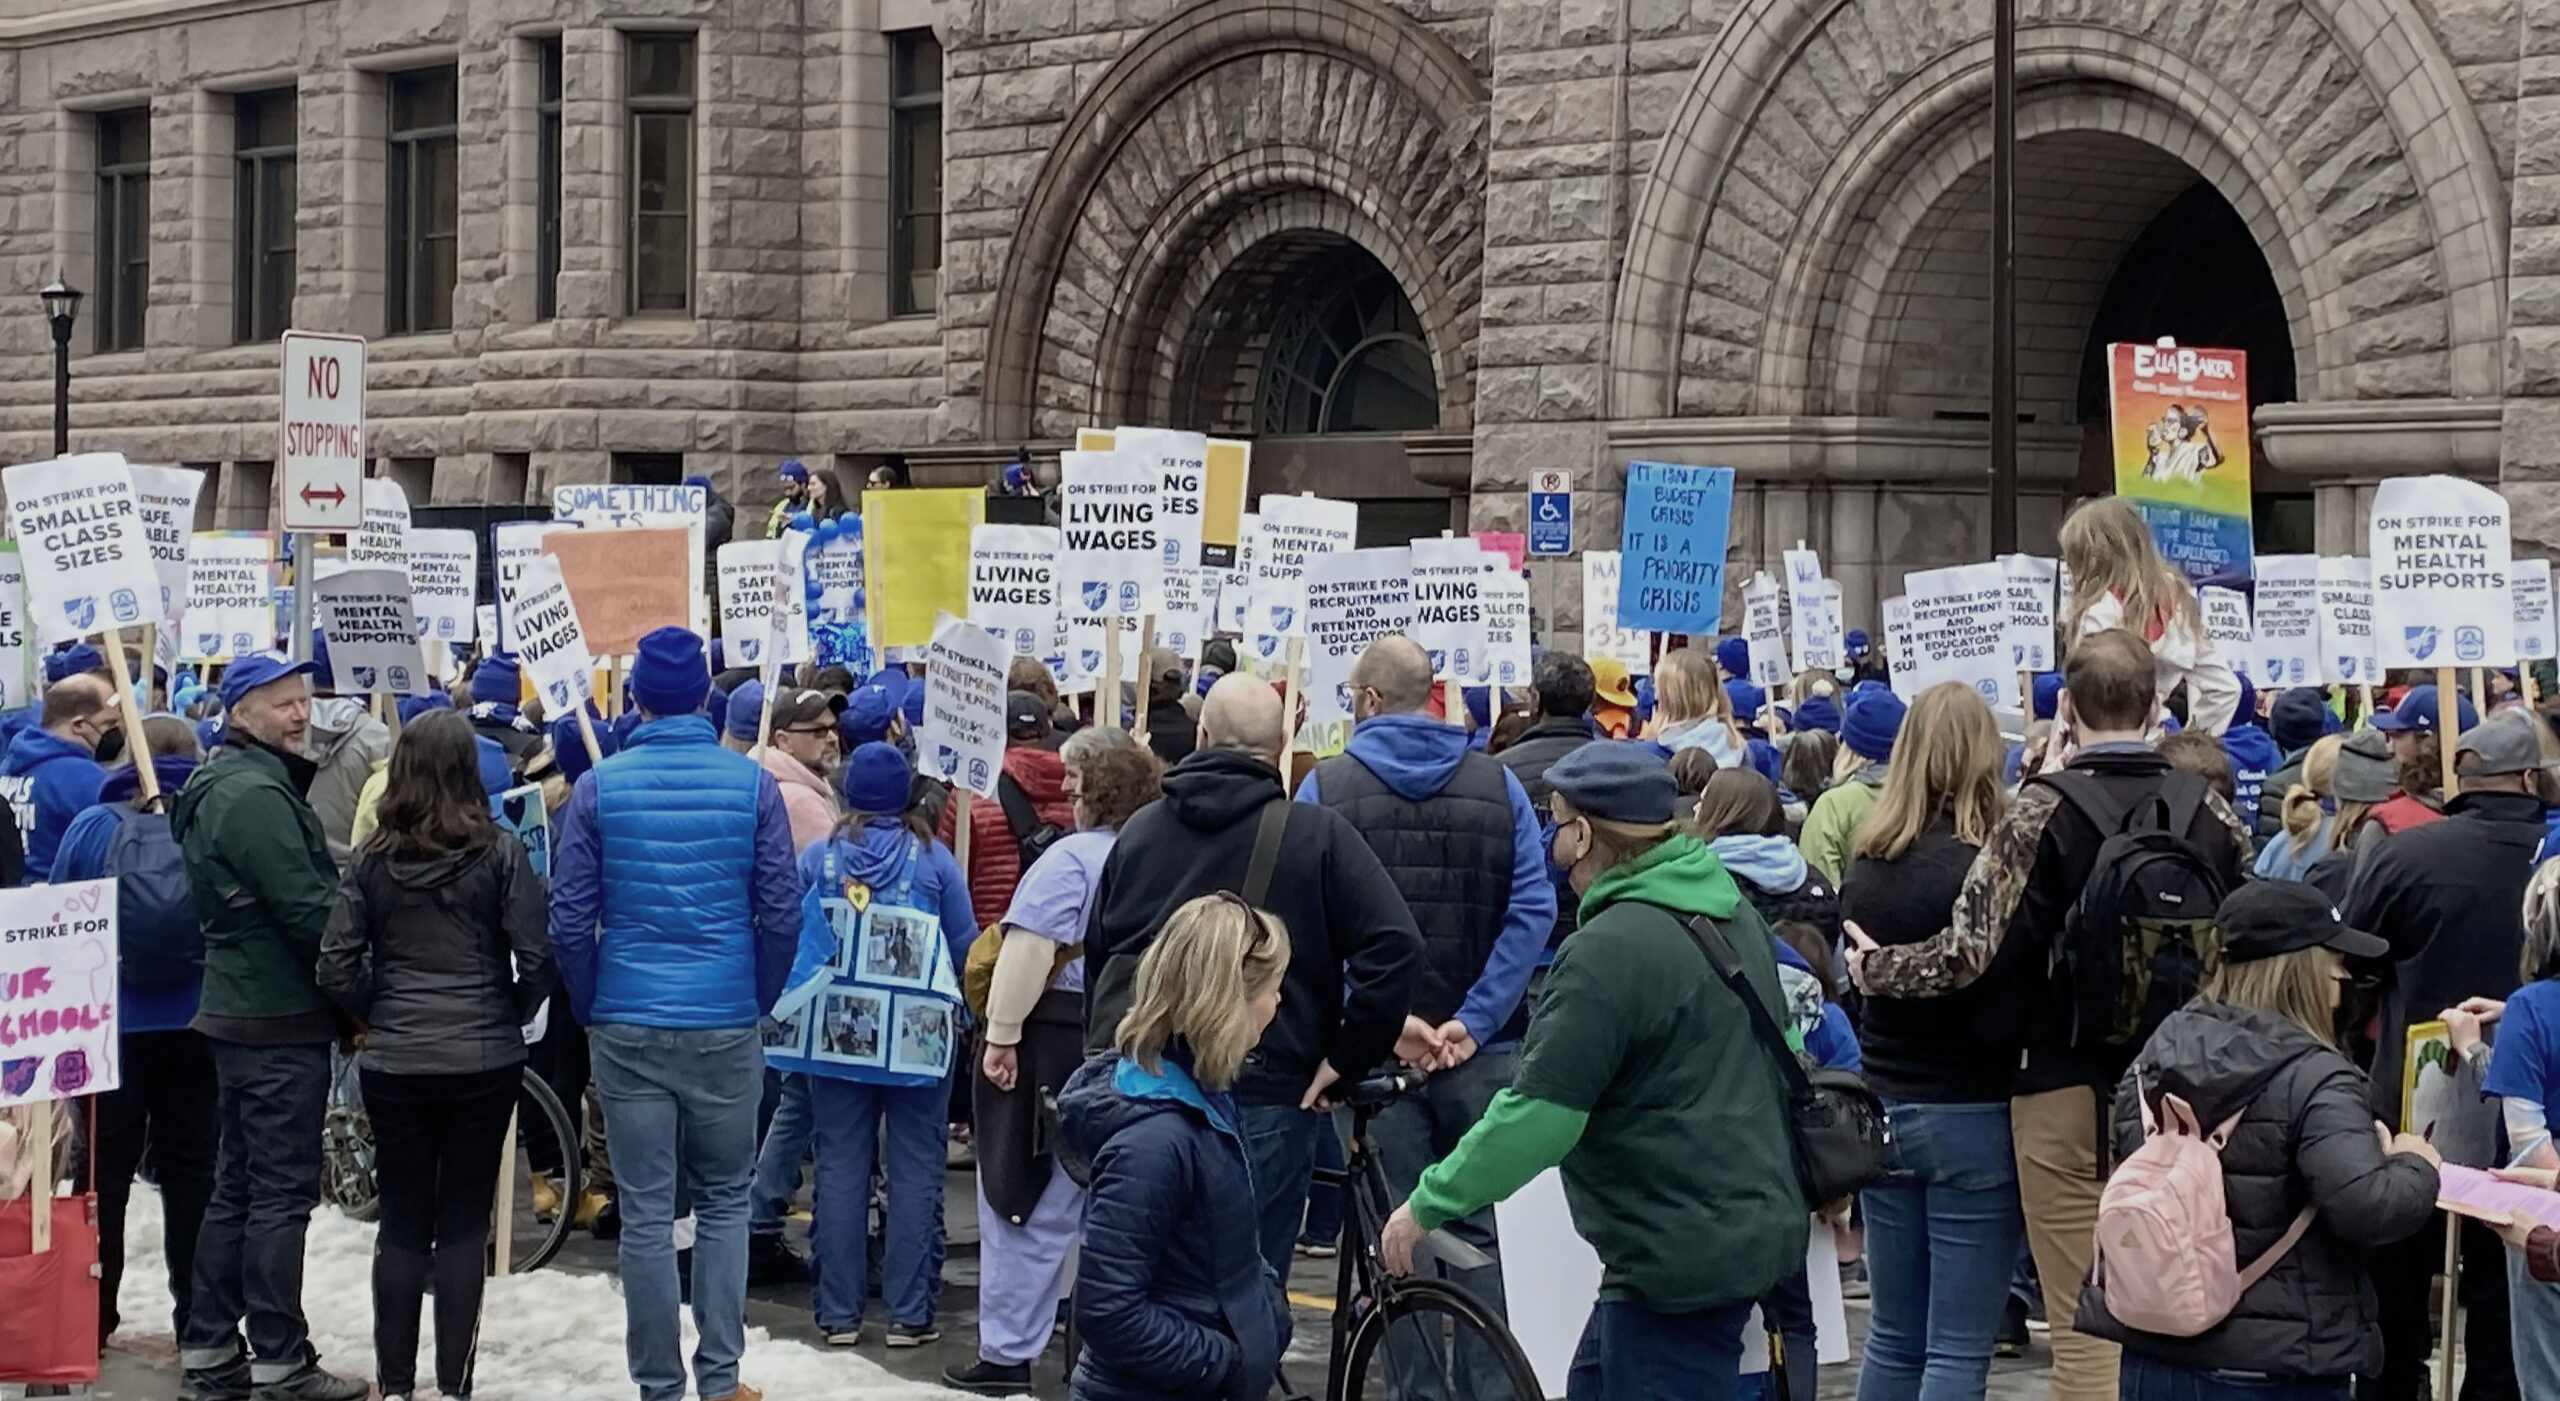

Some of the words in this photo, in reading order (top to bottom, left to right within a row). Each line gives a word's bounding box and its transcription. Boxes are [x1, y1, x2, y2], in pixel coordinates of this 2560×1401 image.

[308, 355, 340, 399] NO
[288, 422, 358, 458] STOPPING
[1180, 458, 1203, 468] FOR
[1706, 470, 1716, 487] A
[16, 499, 39, 513] ON
[44, 487, 94, 507] STRIKE
[98, 481, 129, 495] FOR
[1068, 485, 1085, 494] ON
[1089, 484, 1129, 495] STRIKE
[1132, 485, 1156, 495] FOR
[1654, 486, 1707, 507] BUDGET
[558, 486, 702, 518] SOMETHING
[20, 499, 134, 536] SMALLER
[1070, 503, 1154, 524] LIVING
[1651, 506, 1694, 526] CRISIS
[2377, 518, 2401, 530] ON
[2406, 516, 2463, 528] STRIKE
[2468, 515, 2501, 528] FOR
[44, 522, 123, 552] CLASS
[1263, 523, 1280, 533] ON
[1283, 525, 1323, 538] STRIKE
[1326, 529, 1349, 540] FOR
[360, 536, 402, 550] HEALTH
[1066, 530, 1157, 550] WAGES
[1629, 532, 1645, 551] IT
[1654, 534, 1668, 552] IS
[1679, 538, 1691, 555] A
[2394, 533, 2487, 551] MENTAL
[54, 544, 124, 572] SIZES
[150, 545, 185, 562] OOLS
[351, 549, 409, 565] SUPPORTS
[499, 549, 517, 558] ON
[519, 548, 541, 558] STR
[975, 550, 991, 560] ON
[993, 550, 1029, 561] STRIKE
[1031, 552, 1054, 562] FOR
[1273, 553, 1304, 565] HEA
[202, 558, 241, 566] STRIKE
[411, 562, 461, 573] MENTAL
[722, 566, 737, 575] ON
[738, 563, 775, 574] STRIKE
[2397, 553, 2485, 570] HEALTH
[192, 570, 257, 581] MENTAL
[976, 565, 1051, 584] LIVING
[1259, 564, 1303, 580] SUPP
[1412, 567, 1427, 576] ON
[1429, 567, 1460, 576] STRIKE
[1463, 566, 1479, 575] FOR
[1643, 556, 1720, 587] PRIORITY
[412, 574, 461, 585] HEALTH
[1309, 585, 1327, 594] ON
[1331, 581, 1377, 593] STRIKE
[1381, 578, 1408, 589] FOR
[2379, 573, 2505, 590] SUPPORTS
[194, 583, 256, 595] HEALTH
[973, 587, 1052, 605] WAGES
[1415, 582, 1478, 601] LIVING
[321, 594, 338, 603] ON
[341, 594, 383, 603] STRIKE
[386, 595, 408, 604] FOR
[731, 591, 773, 604] STAB
[1310, 592, 1410, 609] RECRUITMENT
[1640, 588, 1701, 614] CRISIS
[1913, 599, 1930, 608] ON
[1933, 593, 1973, 606] STRIKE
[1977, 589, 2001, 600] FOR
[334, 606, 402, 618] MENTAL
[723, 602, 803, 620] SCHOS
[1166, 600, 1198, 612] ORTS
[1345, 607, 1376, 619] AND
[1484, 603, 1525, 615] ALLER
[1914, 601, 2002, 620] RECRUITMENT
[2008, 601, 2043, 613] TABLE
[338, 618, 402, 630] HEALTH
[515, 600, 569, 642] LIVING
[1311, 619, 1391, 633] RETENTION
[1394, 616, 1412, 627] OF
[1489, 617, 1516, 629] ASS
[1888, 621, 1904, 632] ON
[1946, 616, 1974, 627] AND
[1989, 621, 2005, 632] OF
[328, 632, 416, 646] SUPPORTS
[1487, 631, 1513, 643] ZES
[1916, 625, 1987, 642] RETENTION
[521, 622, 579, 664] WAGES
[1329, 645, 1348, 656] OF
[1925, 635, 1999, 652] EDUCATORS
[1952, 644, 1995, 658] COLOR
[932, 642, 946, 655] ON
[947, 649, 985, 670] STRIKE
[1932, 651, 1949, 661] OF
[5, 923, 68, 943] STRIKE
[73, 918, 109, 935] FOR
